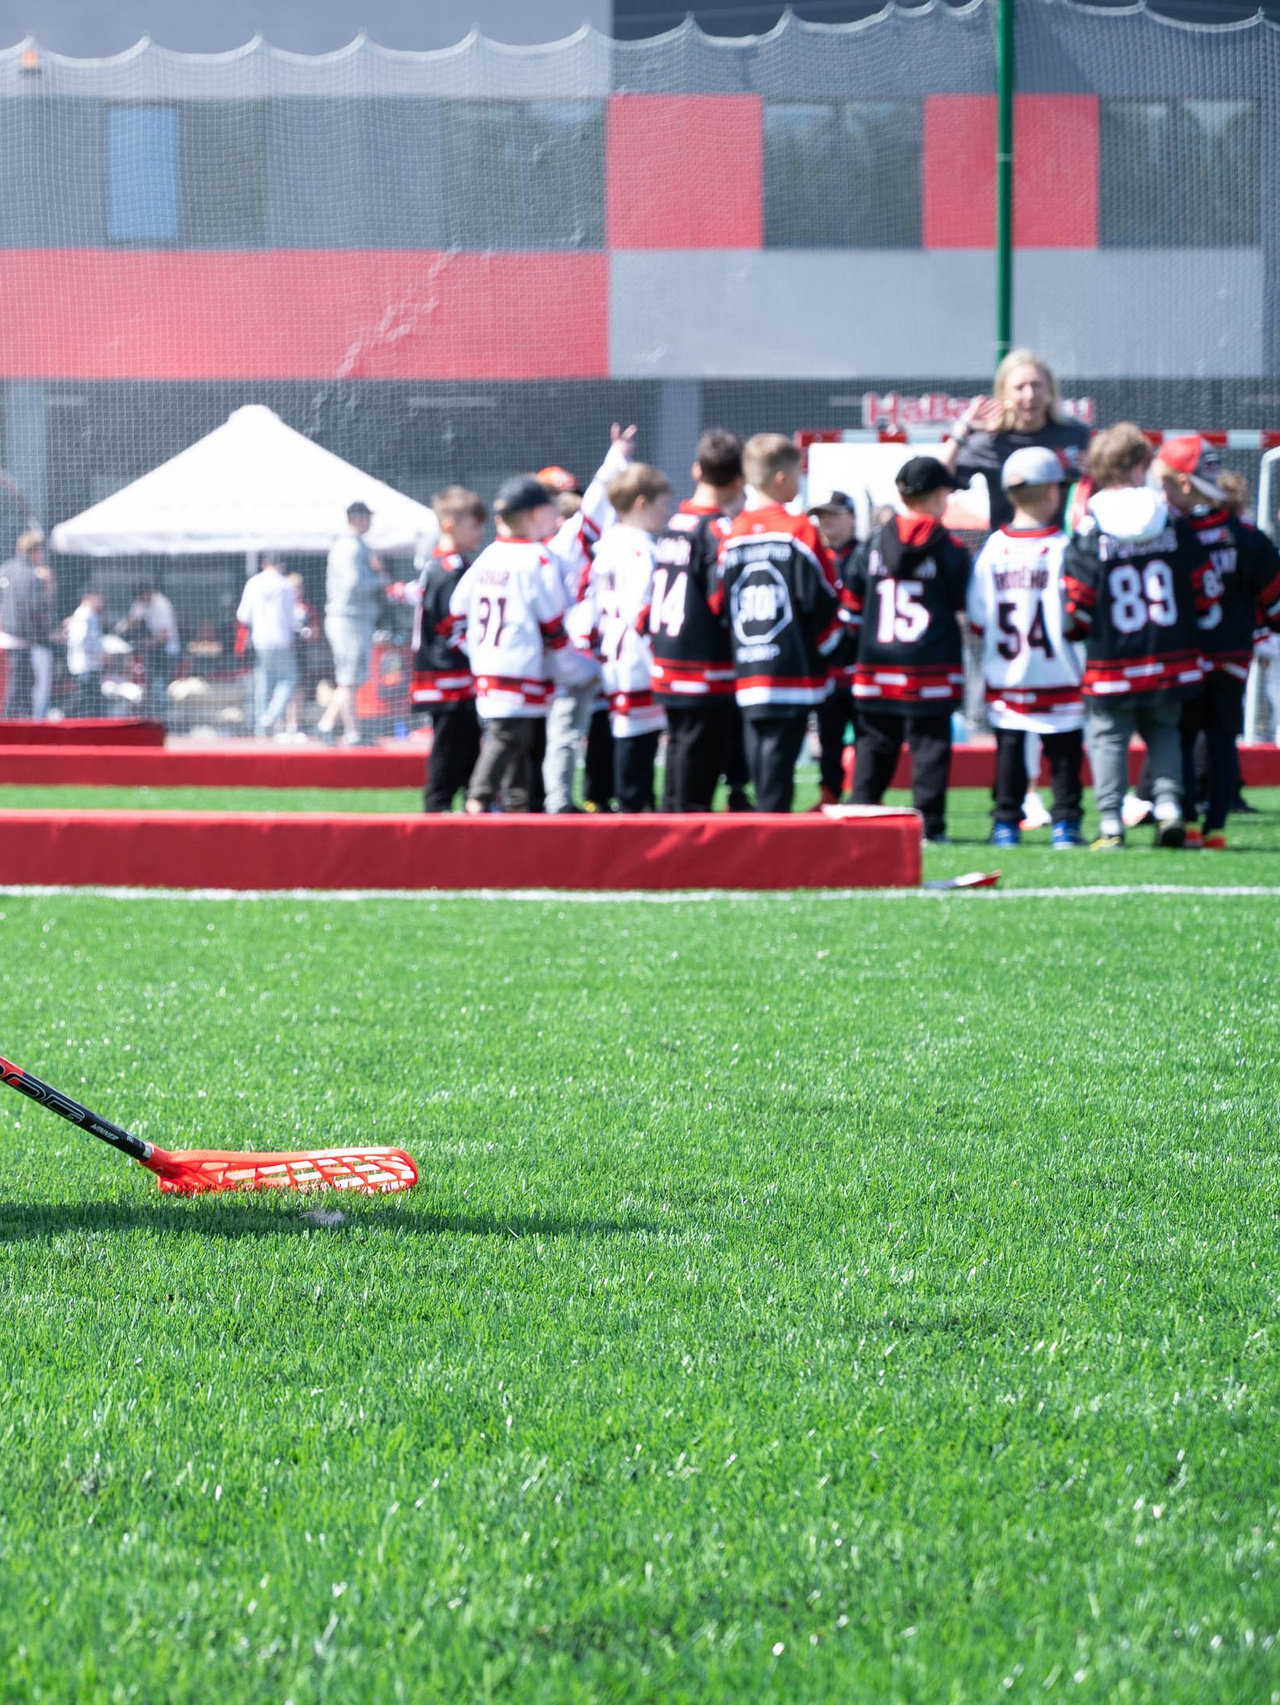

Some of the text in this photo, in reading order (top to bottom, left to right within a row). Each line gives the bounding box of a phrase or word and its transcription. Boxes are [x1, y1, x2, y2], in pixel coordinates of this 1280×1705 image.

[649, 567, 688, 638] 14
[876, 578, 930, 643] 15
[997, 600, 1055, 660] 54
[1109, 559, 1179, 633] 89
